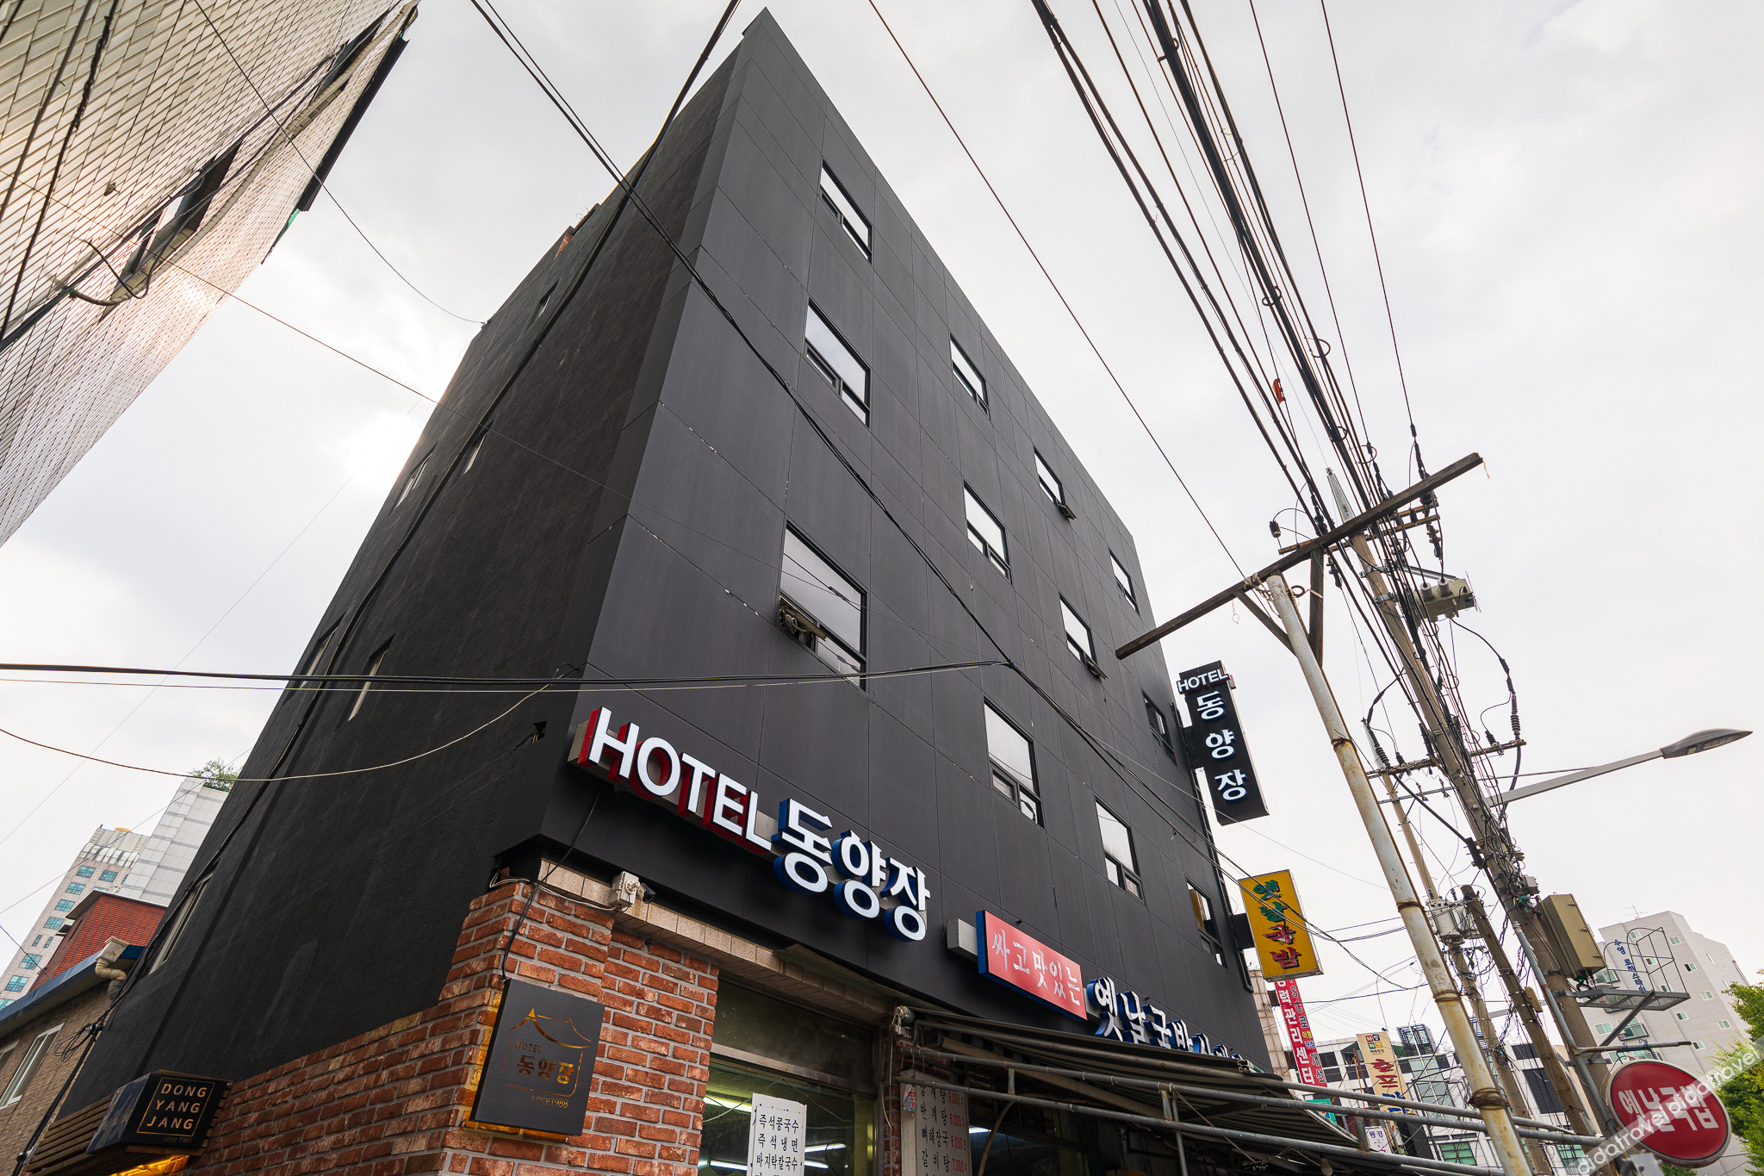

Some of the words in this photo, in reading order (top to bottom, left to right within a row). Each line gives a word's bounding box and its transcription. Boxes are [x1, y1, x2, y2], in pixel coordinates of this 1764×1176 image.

[1177, 669, 1228, 693] HOTEL
[1197, 691, 1246, 801] 동양장
[587, 706, 772, 852] HOTEL
[775, 798, 931, 942] 동양장
[1252, 879, 1302, 969] 옛날국밥
[514, 1041, 541, 1054] HOTEL
[516, 1054, 575, 1084] 동양장
[161, 1083, 208, 1098] DONG
[155, 1099, 201, 1114] YANG
[146, 1116, 194, 1130] JANG
[759, 1114, 799, 1134] 즉석콩국수
[756, 1152, 798, 1172] 바지락칼국수
